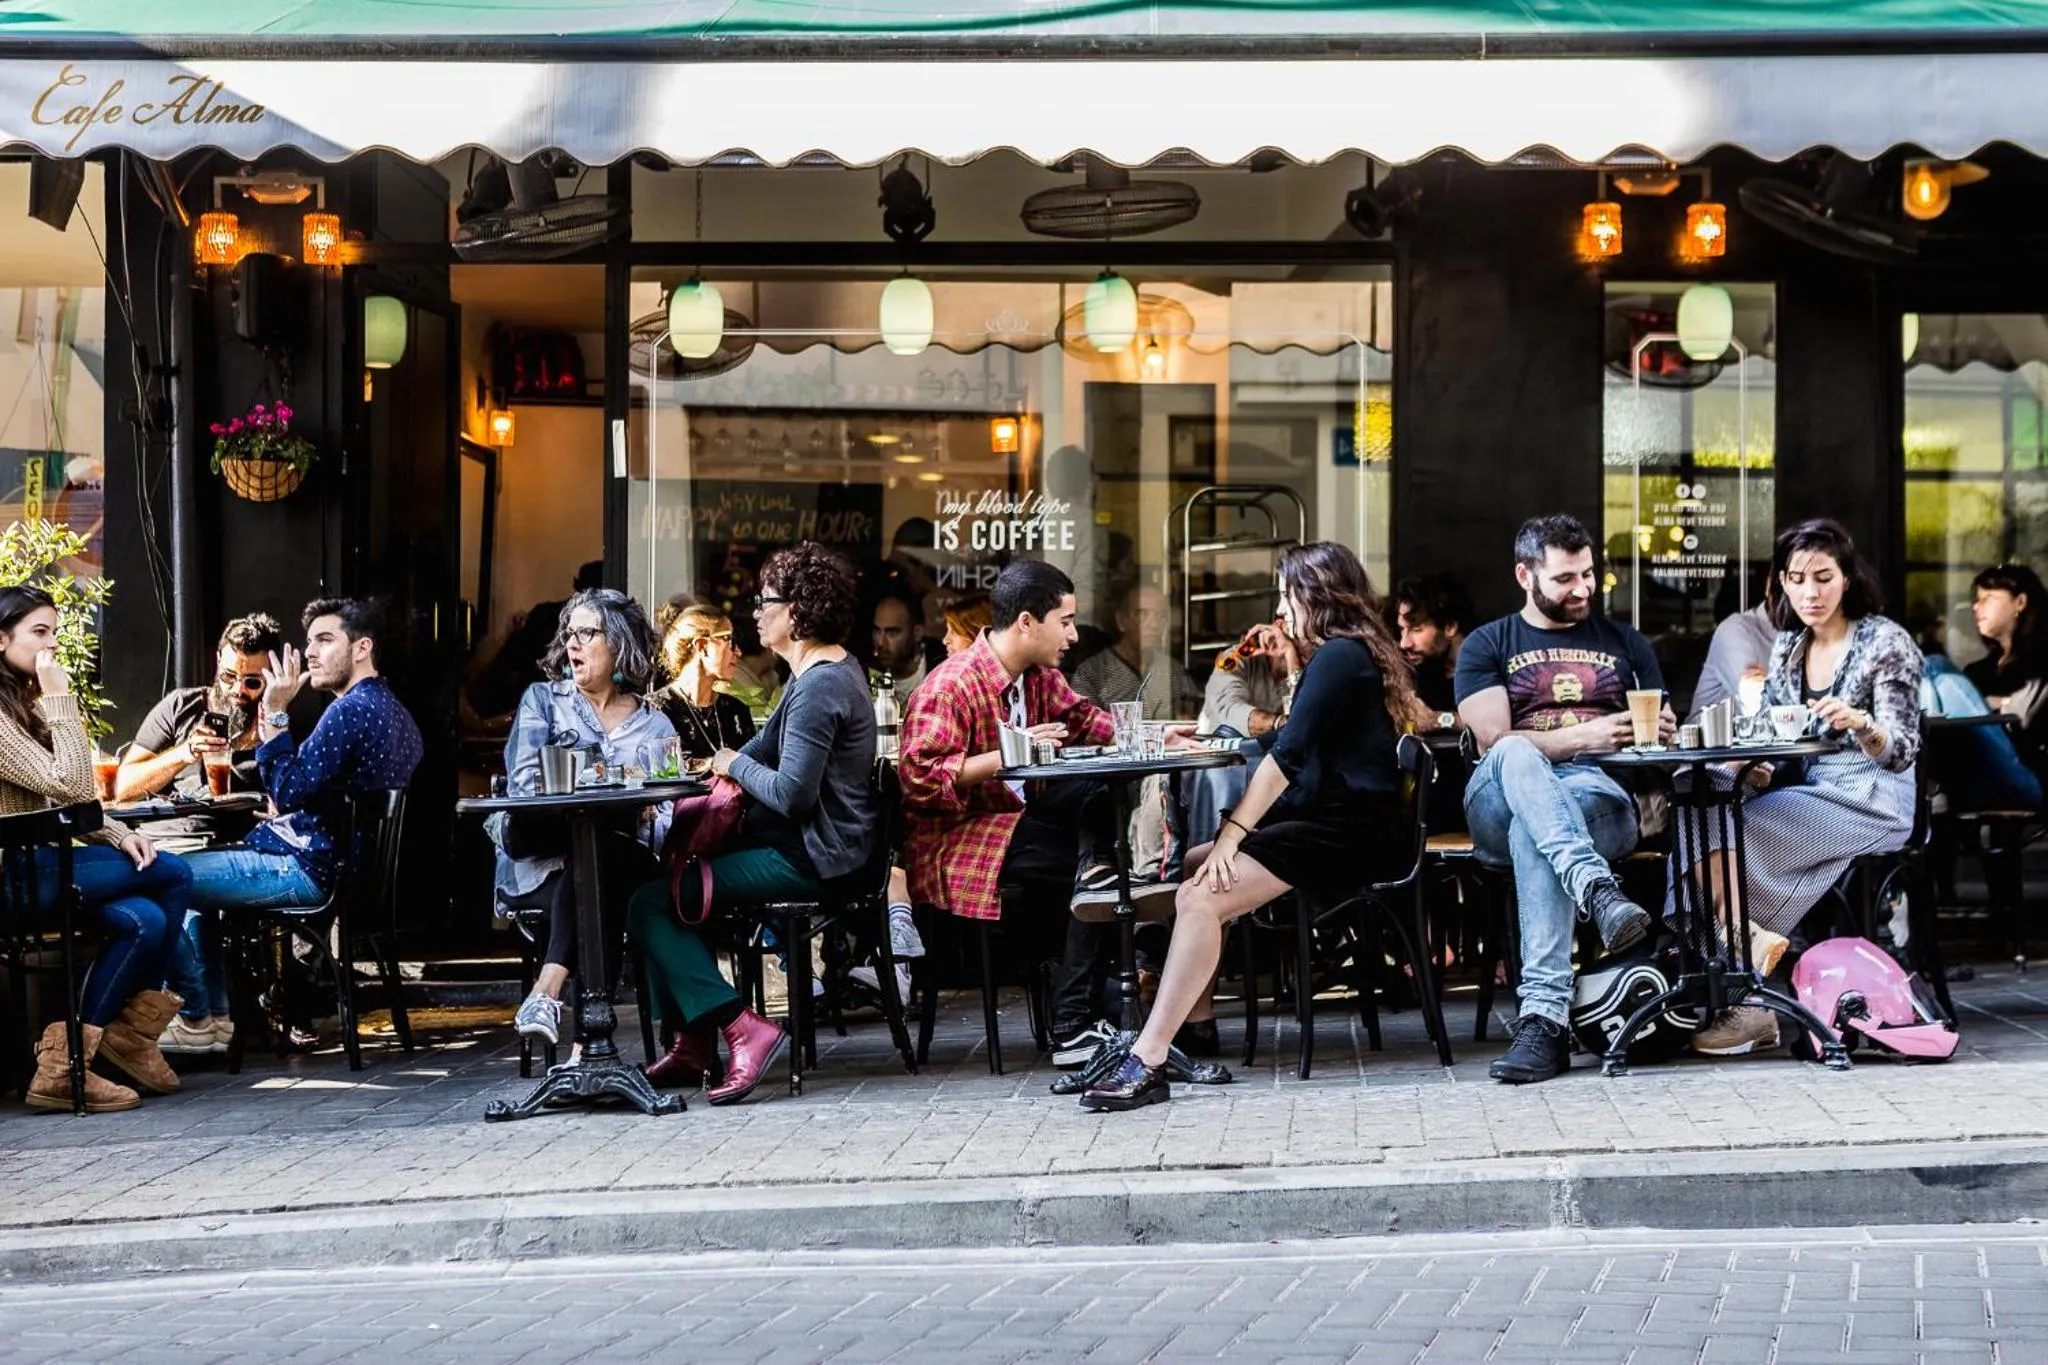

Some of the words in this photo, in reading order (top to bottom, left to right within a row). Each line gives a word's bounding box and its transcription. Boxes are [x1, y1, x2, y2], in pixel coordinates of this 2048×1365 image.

[31, 63, 125, 152] Cafe
[132, 73, 265, 125] Alma
[942, 500, 970, 535] my
[975, 489, 1034, 514] blood
[1029, 495, 1071, 534] type
[934, 520, 960, 551] IS
[971, 520, 1076, 551] COFFEE
